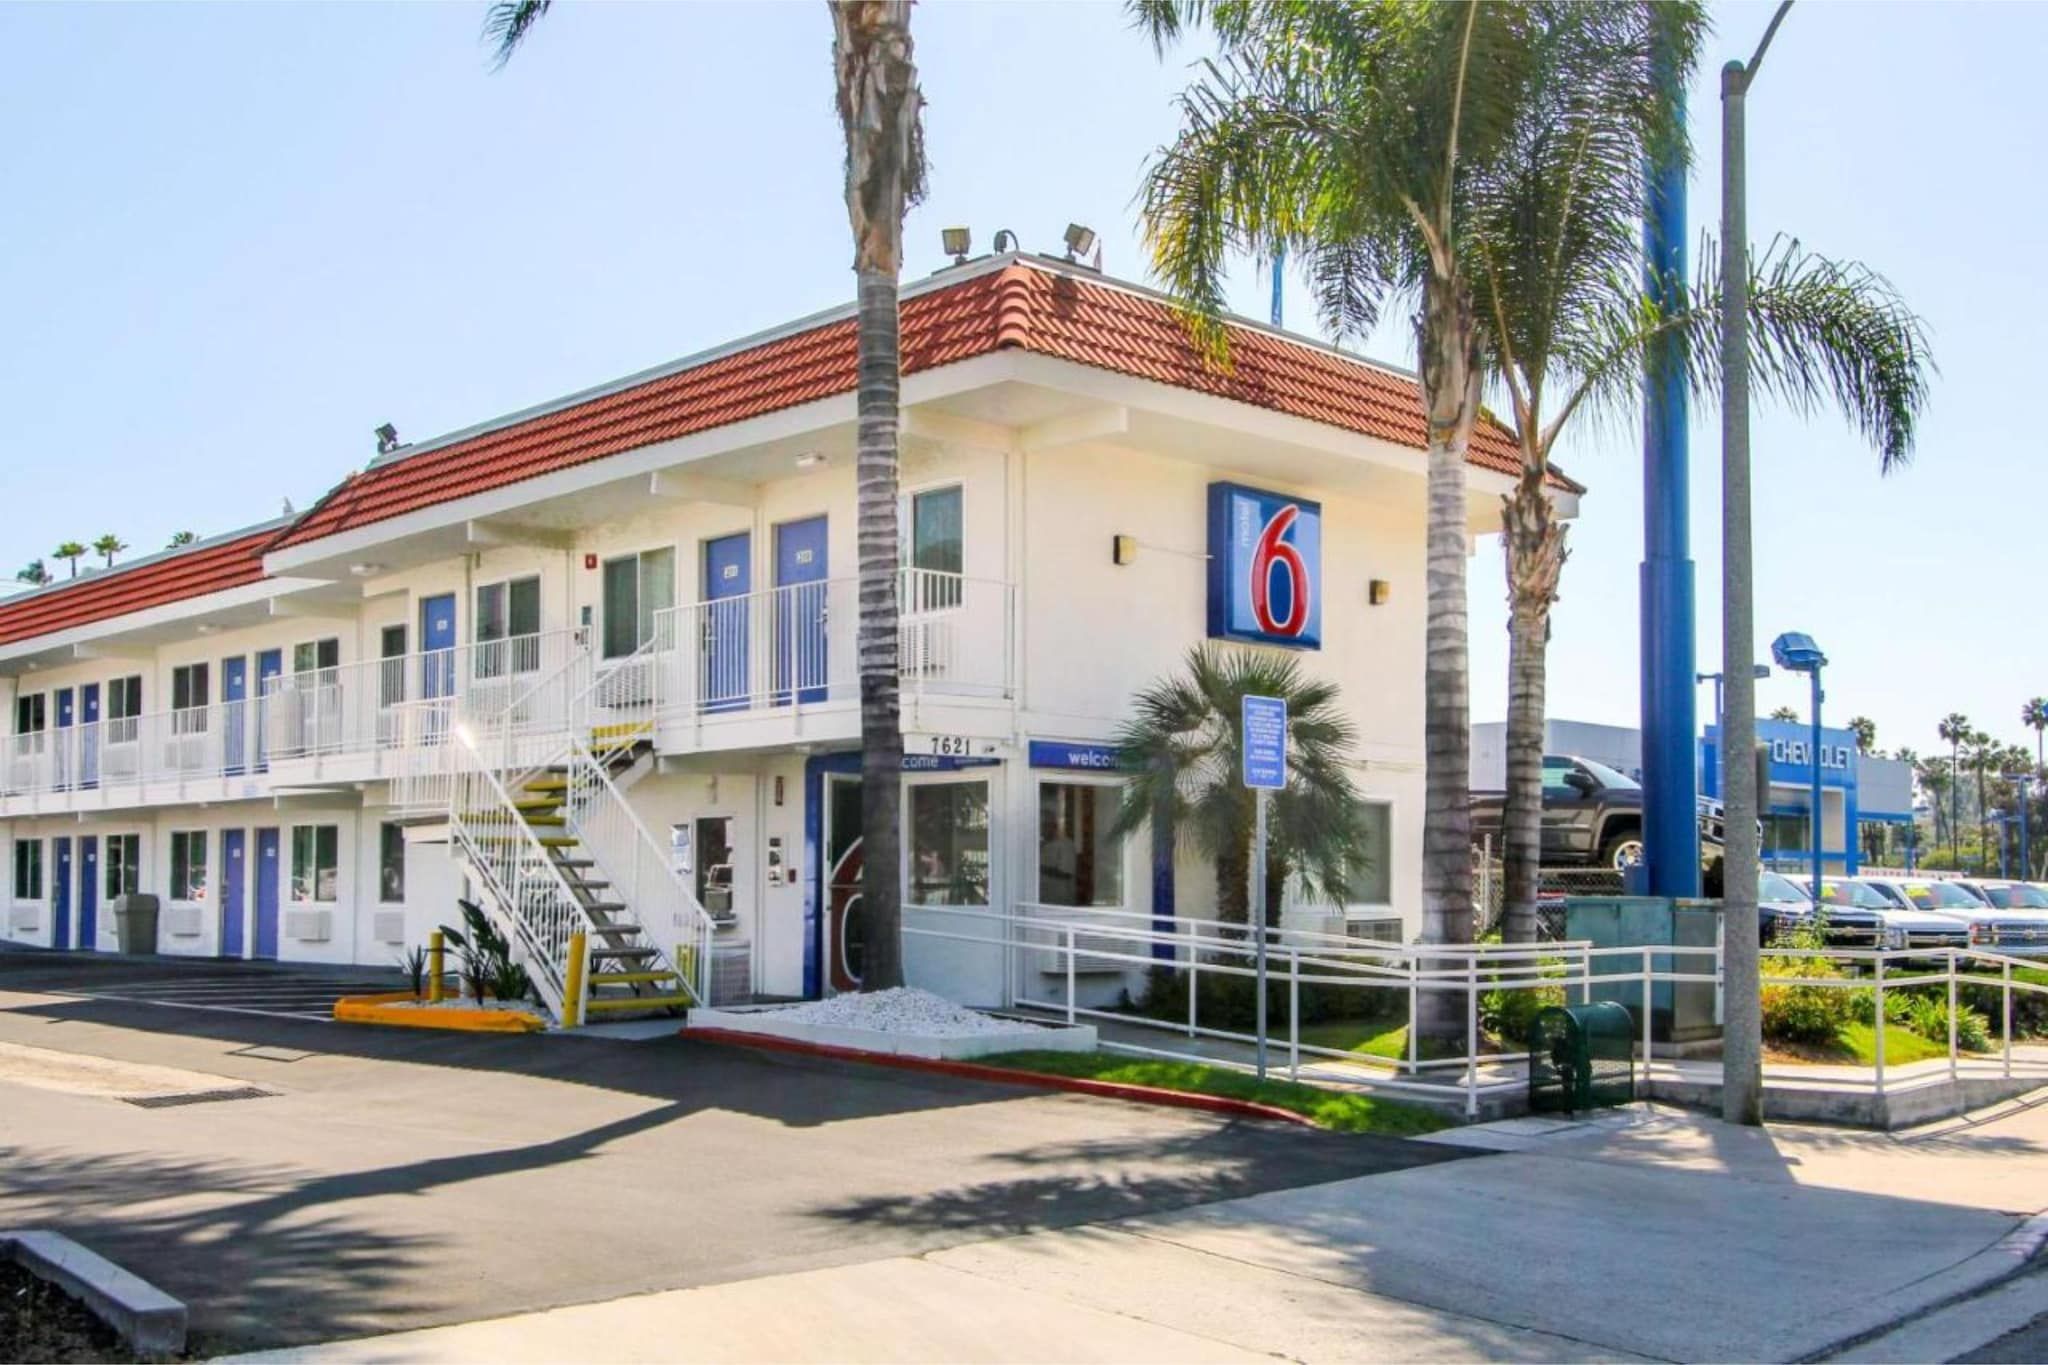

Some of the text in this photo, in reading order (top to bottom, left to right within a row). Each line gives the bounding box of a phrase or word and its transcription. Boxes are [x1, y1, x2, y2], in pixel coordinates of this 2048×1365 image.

[1250, 503, 1310, 637] 6
[931, 737, 970, 755] 7621
[1773, 739, 1851, 768] CHEVOLET
[901, 757, 939, 769] come
